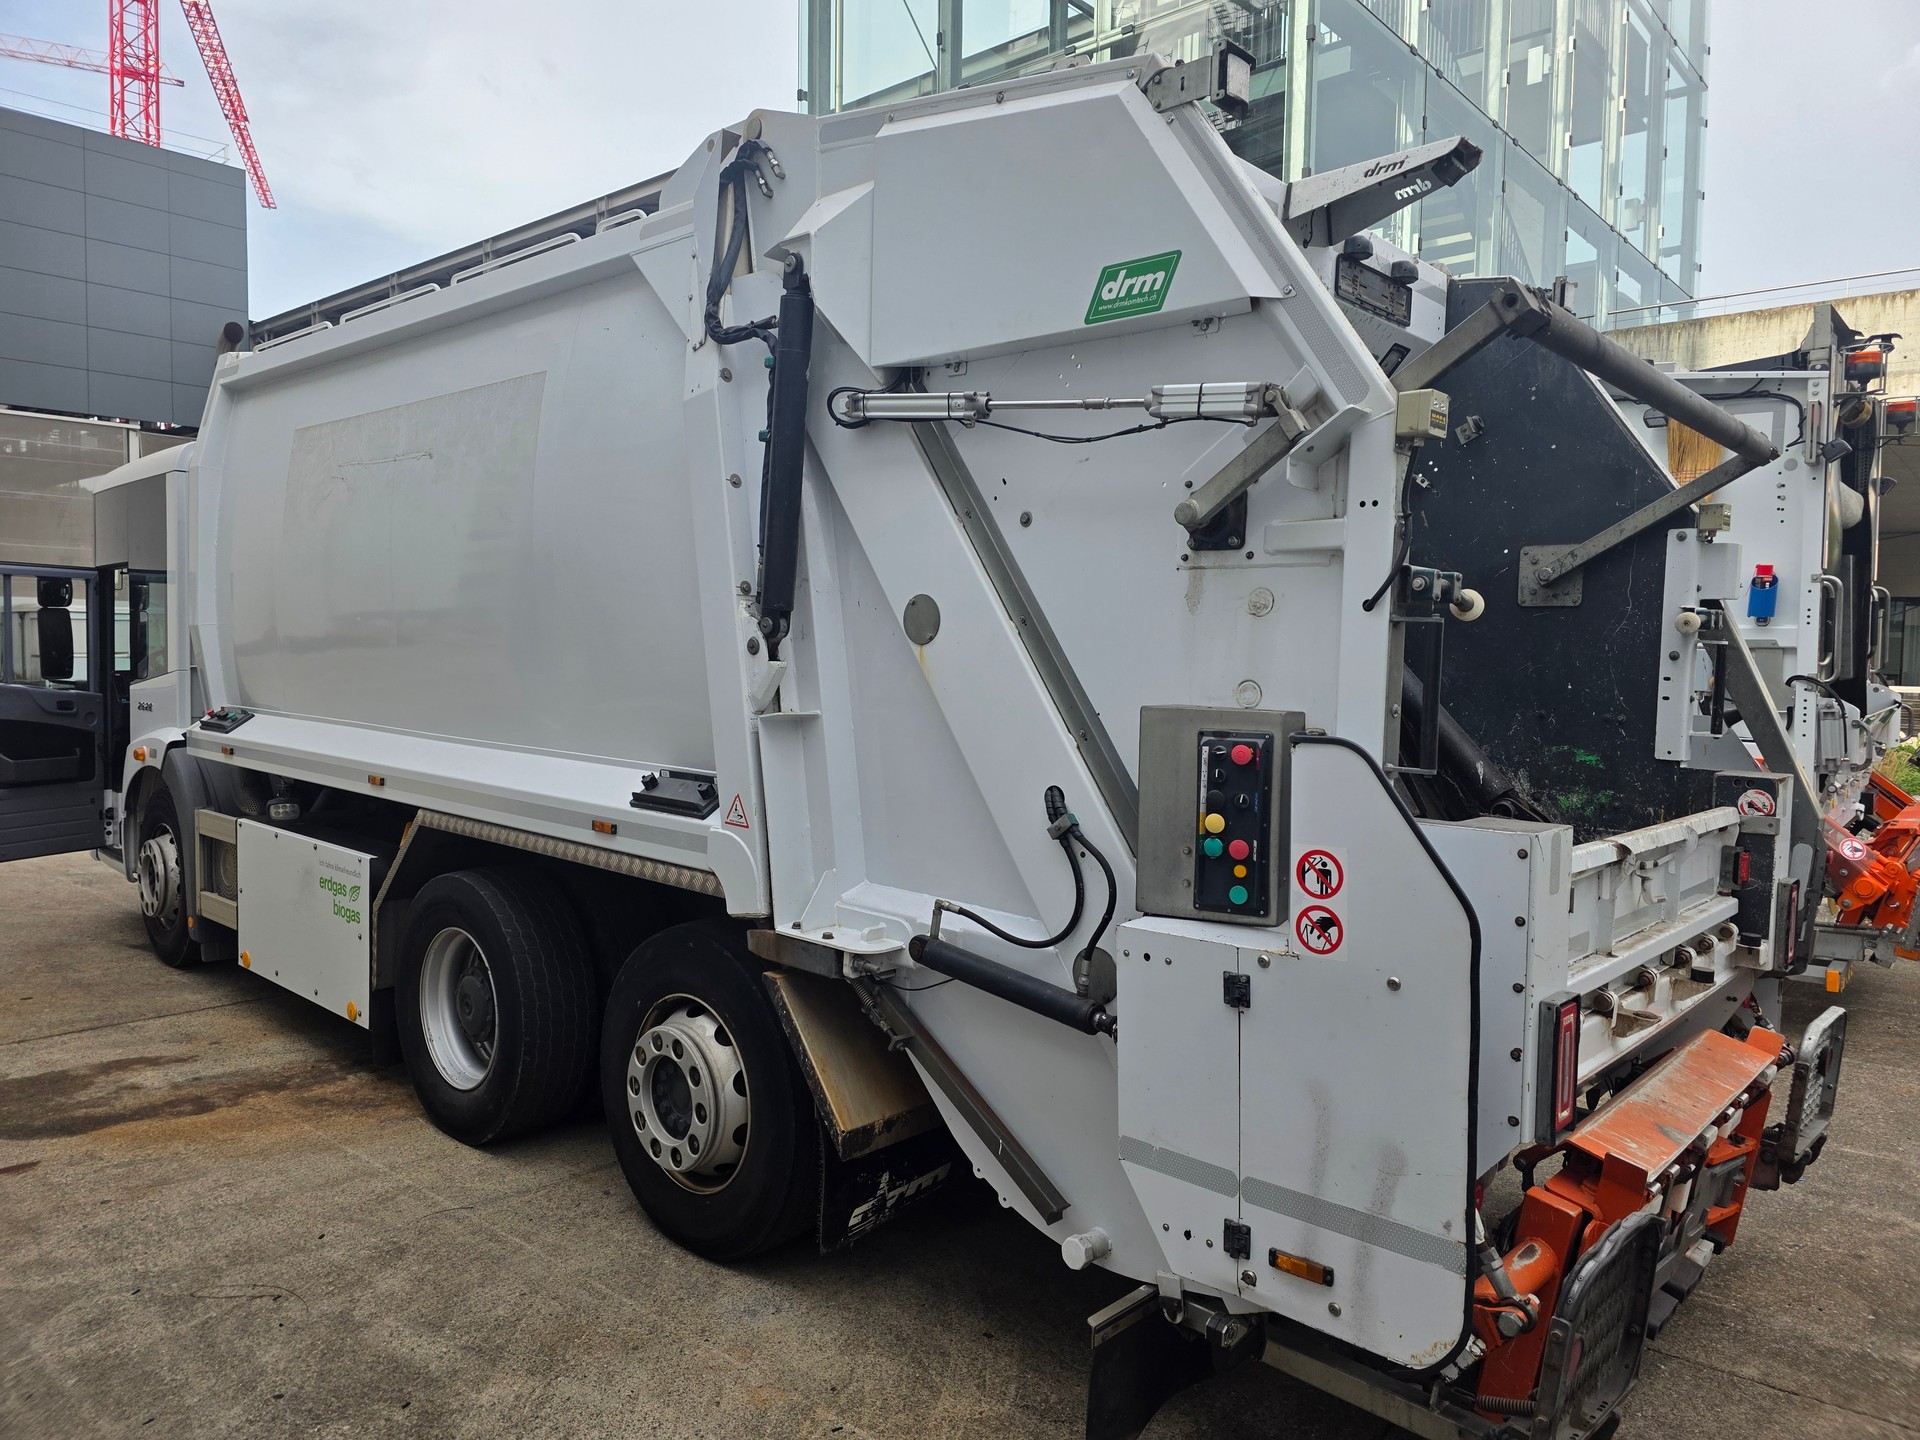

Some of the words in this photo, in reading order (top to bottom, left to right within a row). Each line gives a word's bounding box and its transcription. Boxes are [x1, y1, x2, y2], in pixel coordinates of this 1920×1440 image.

[1364, 160, 1406, 178] drm
[1101, 269, 1166, 301] drm
[319, 876, 347, 897] erdgas
[333, 898, 361, 924] biogas
